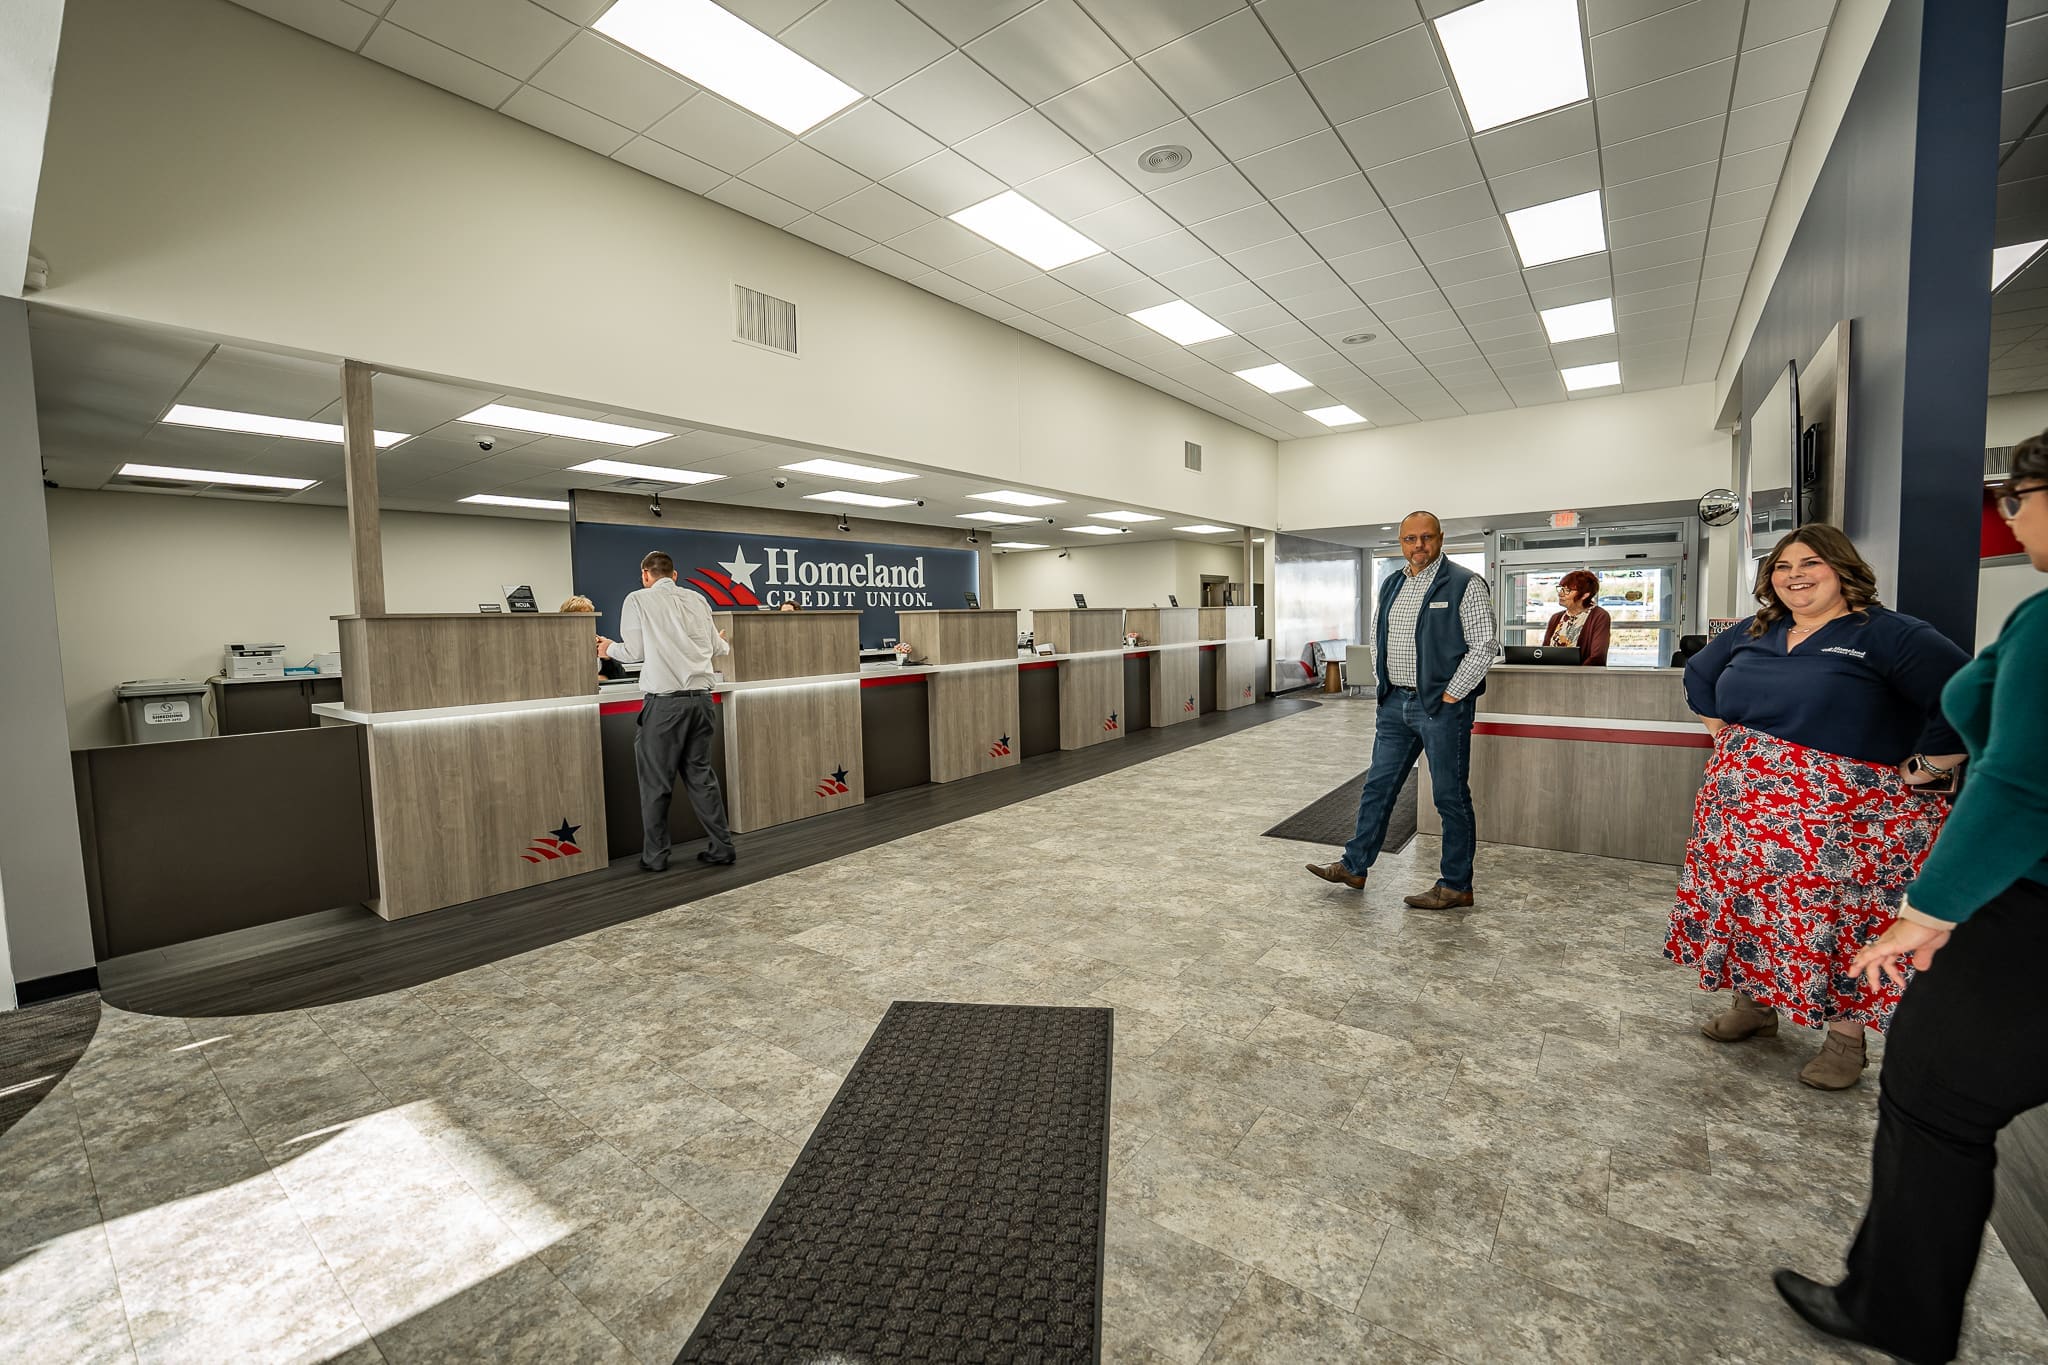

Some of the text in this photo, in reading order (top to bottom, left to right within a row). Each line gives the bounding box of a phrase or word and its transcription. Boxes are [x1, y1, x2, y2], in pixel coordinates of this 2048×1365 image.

[764, 547, 926, 589] Homeland
[766, 591, 928, 608] CREDIT UNION
[1710, 620, 1727, 628] OUR
